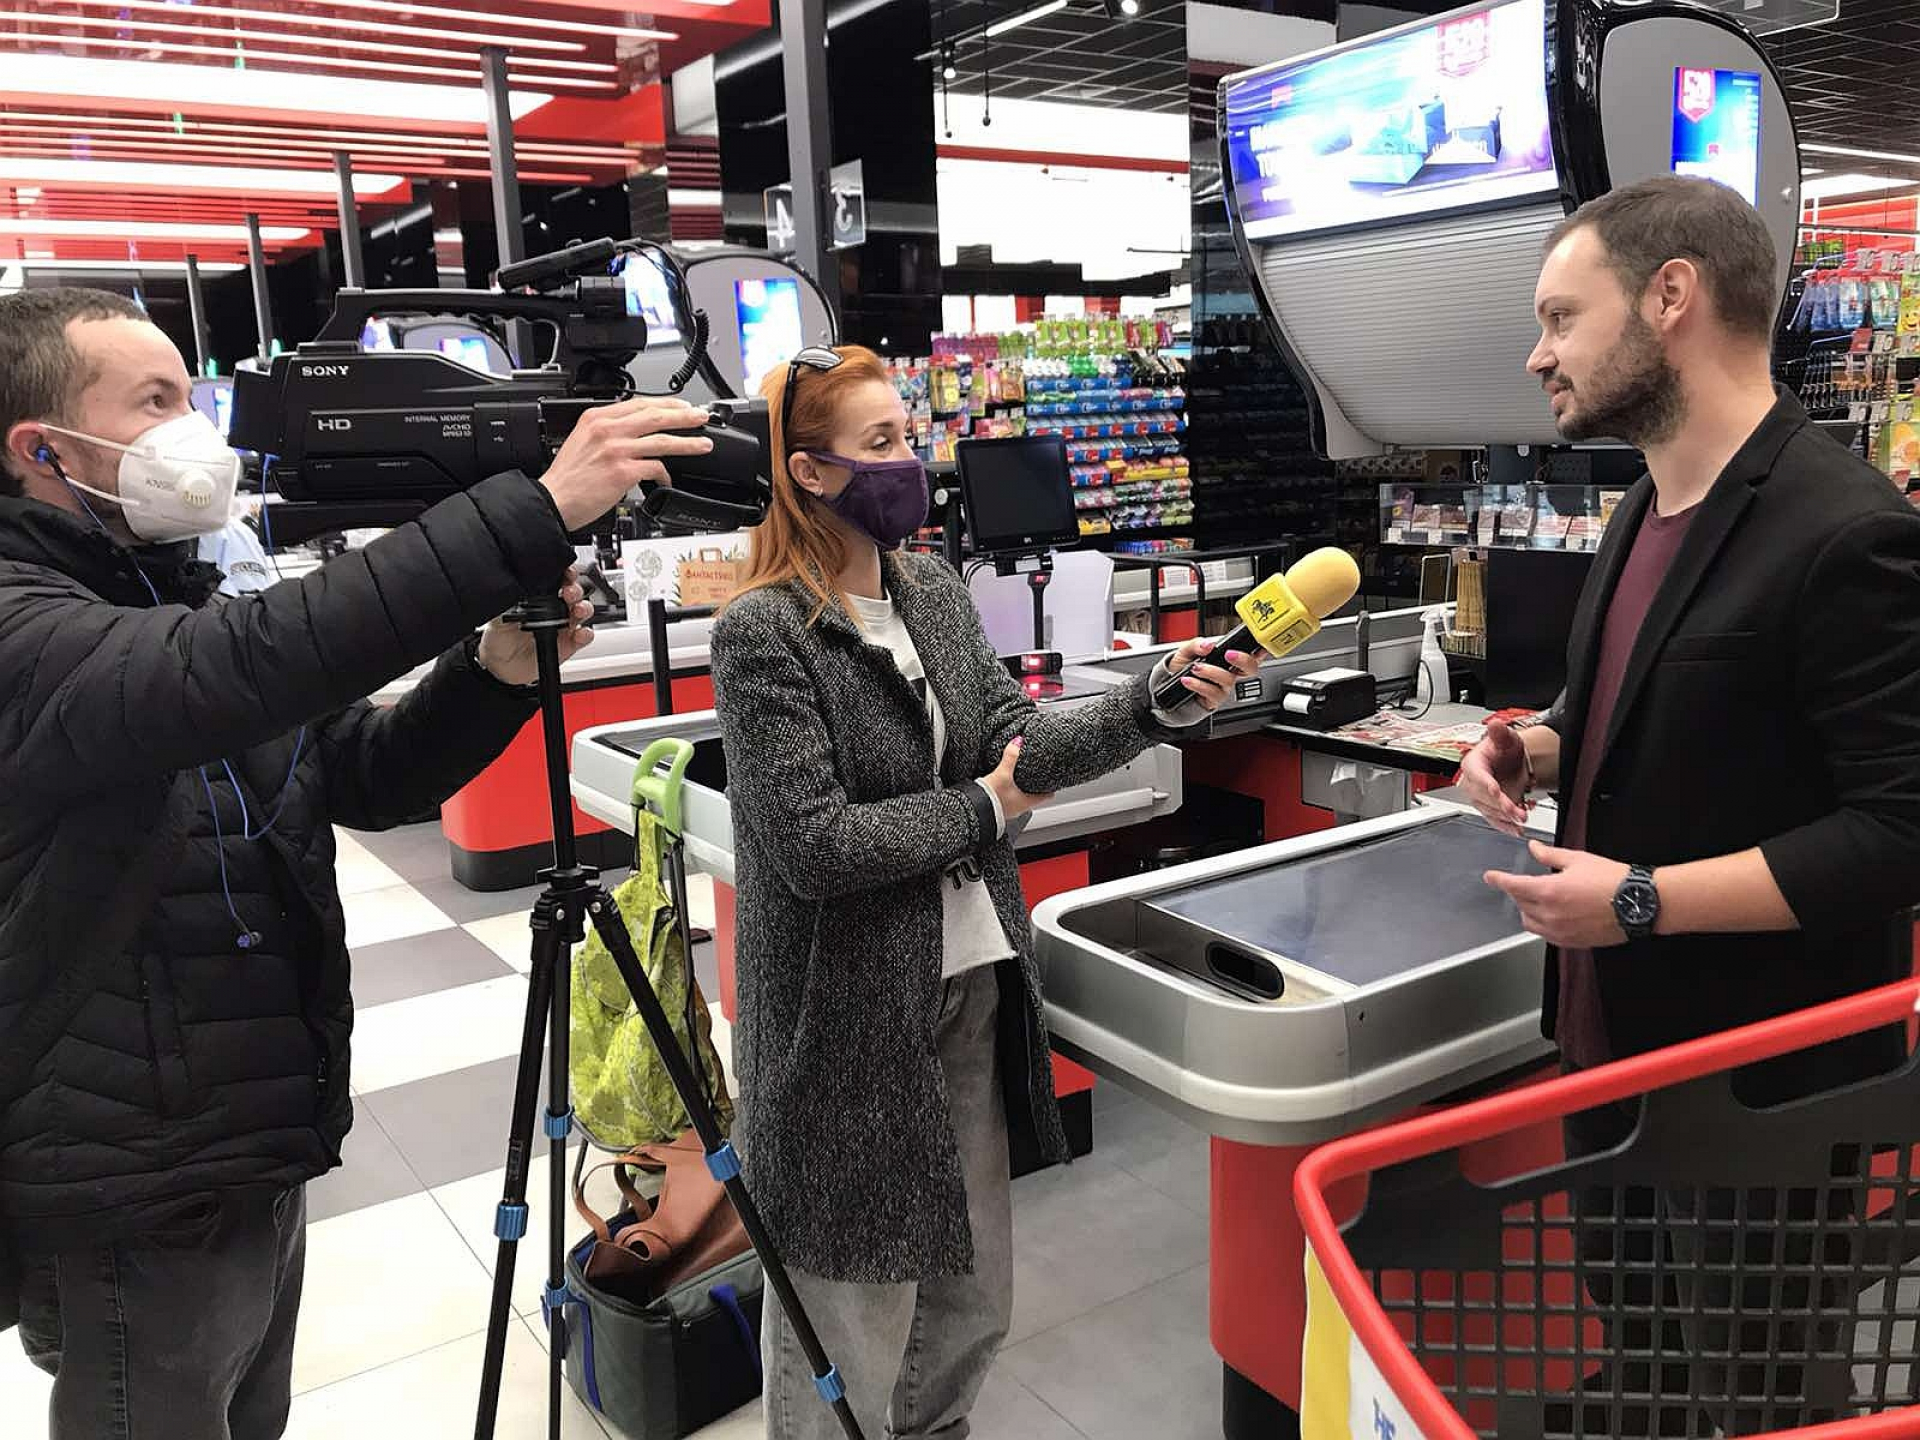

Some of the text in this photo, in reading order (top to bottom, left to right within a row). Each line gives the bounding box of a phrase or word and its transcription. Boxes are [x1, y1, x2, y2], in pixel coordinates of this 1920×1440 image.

[301, 365, 349, 377] SONY
[440, 414, 471, 422] MEMORY
[317, 419, 352, 431] HD
